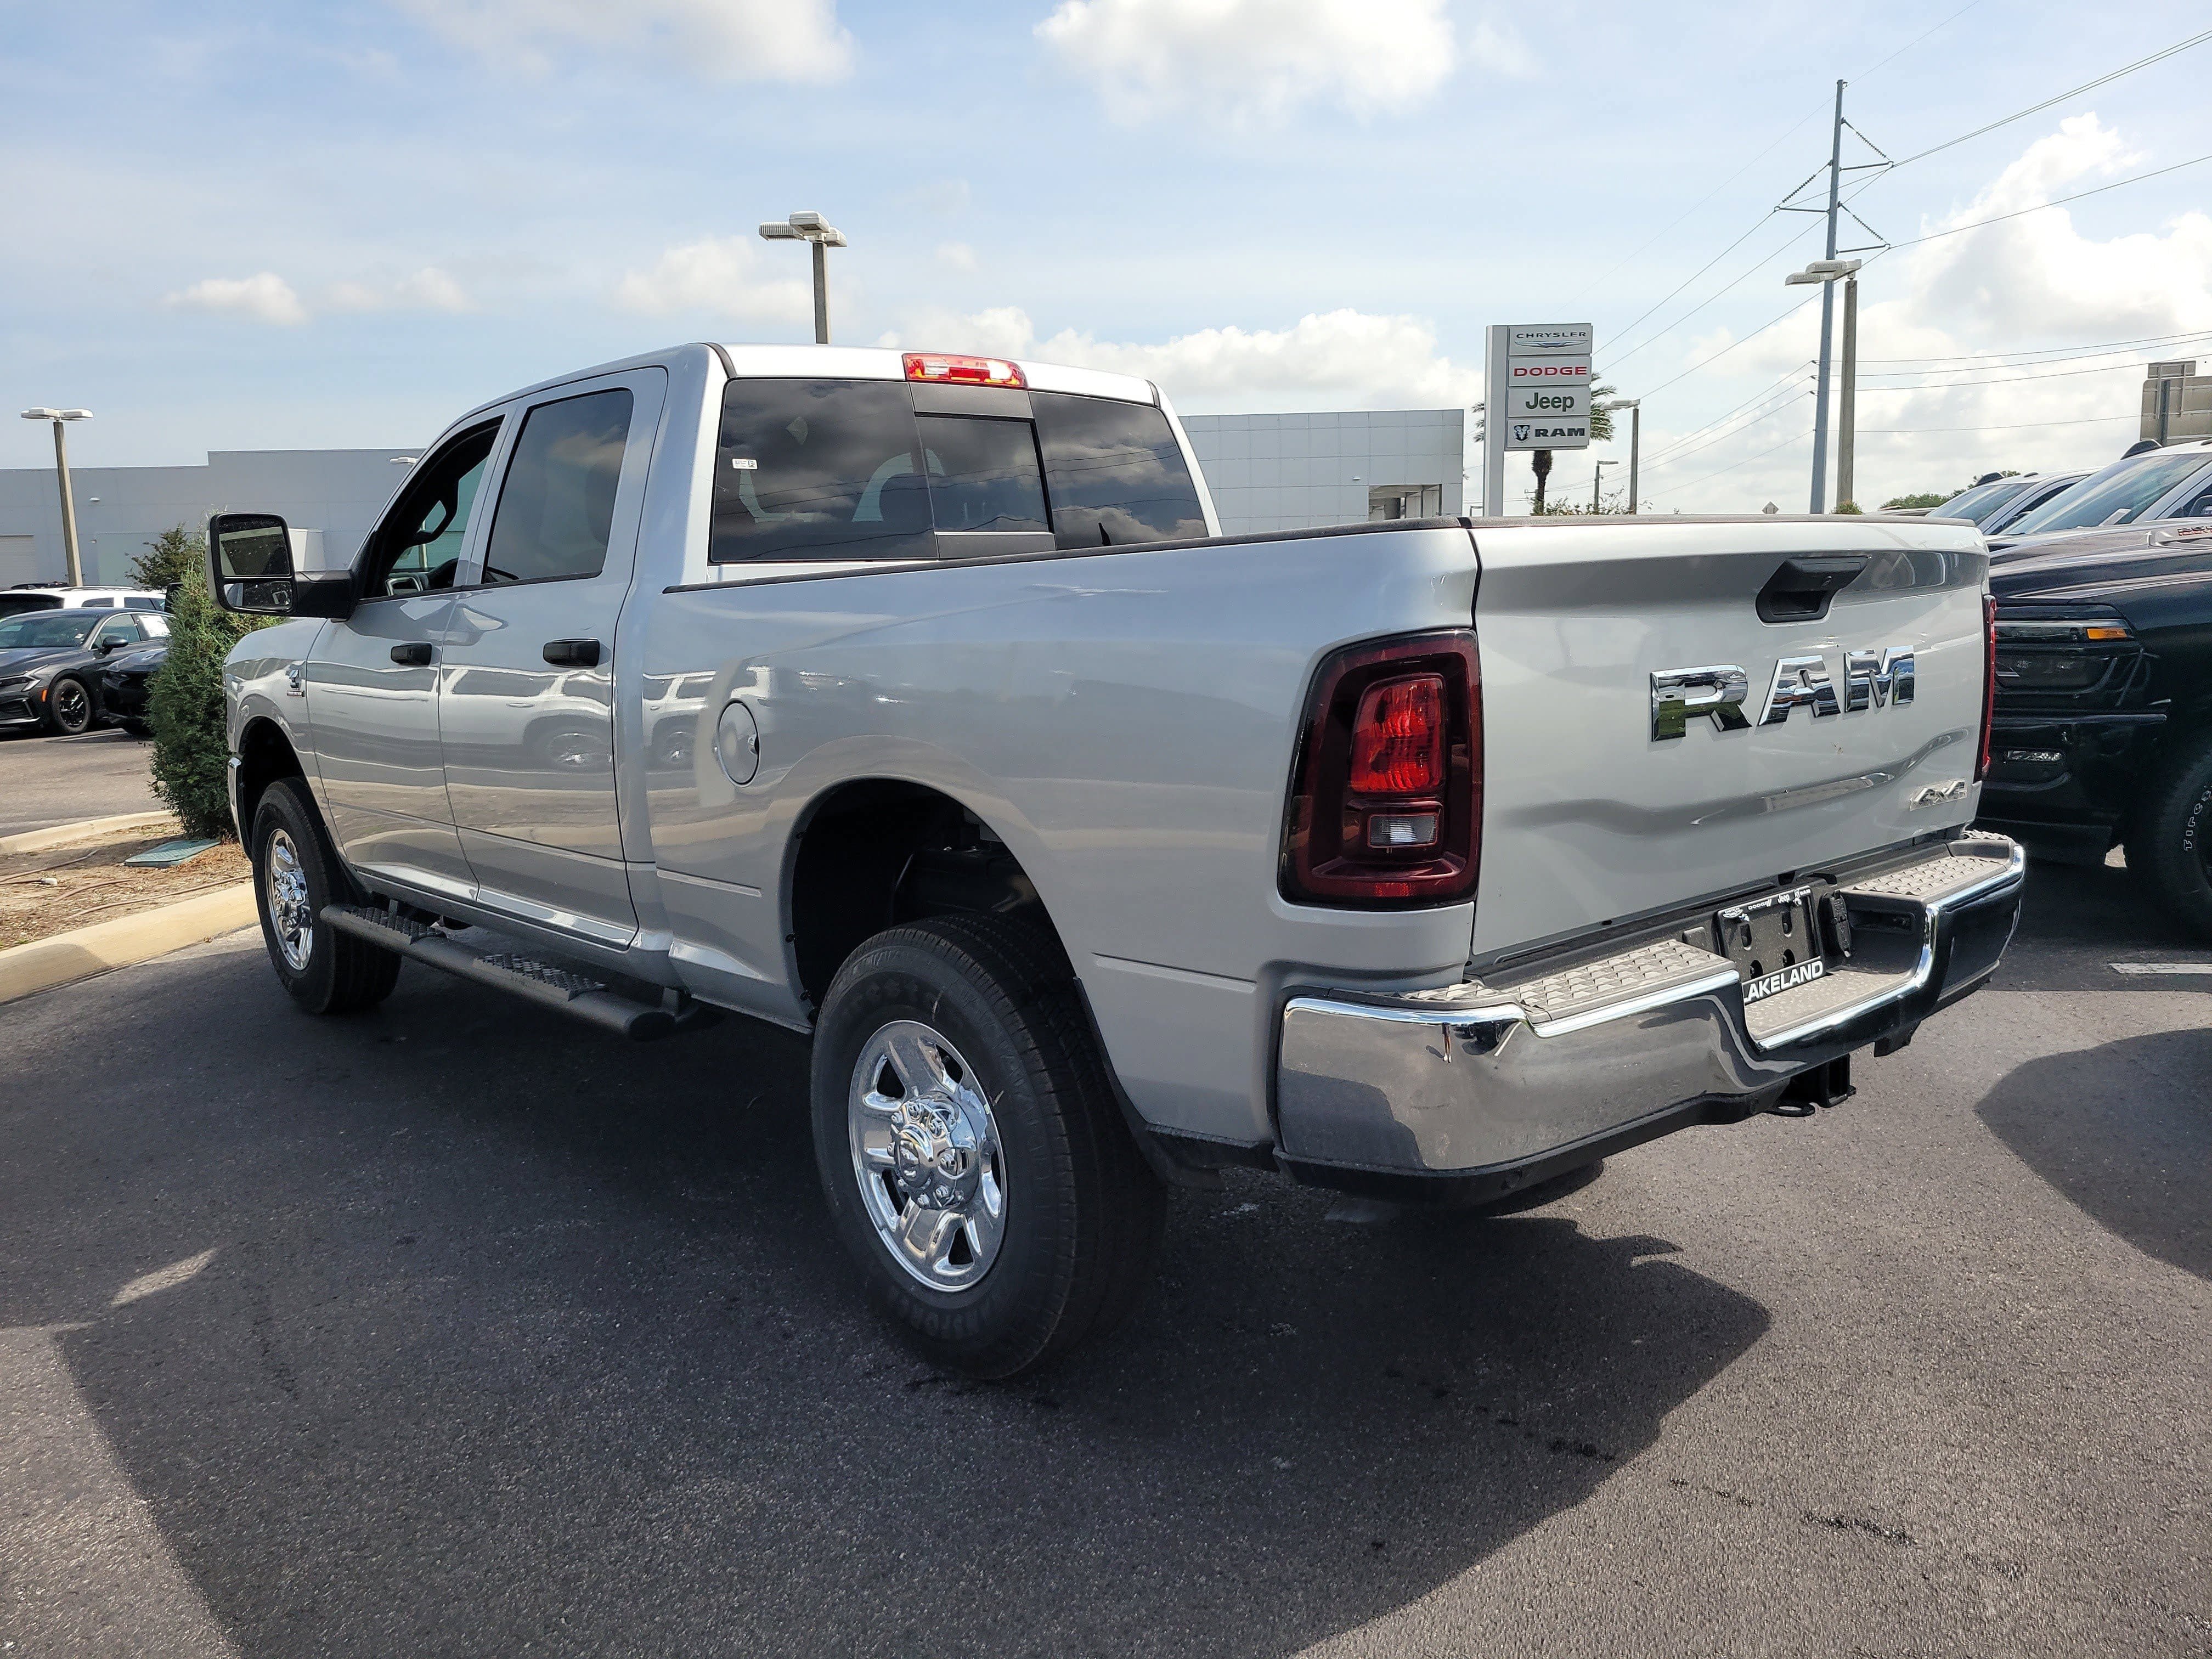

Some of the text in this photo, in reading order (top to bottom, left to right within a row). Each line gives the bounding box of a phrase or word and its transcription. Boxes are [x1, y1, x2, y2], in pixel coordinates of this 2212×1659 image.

[1514, 366, 1587, 377] DODGE
[1525, 392, 1575, 411] Jeep
[1534, 428, 1585, 437] RAM
[1651, 645, 1914, 742] RAM
[1778, 894, 1790, 904] Jeep
